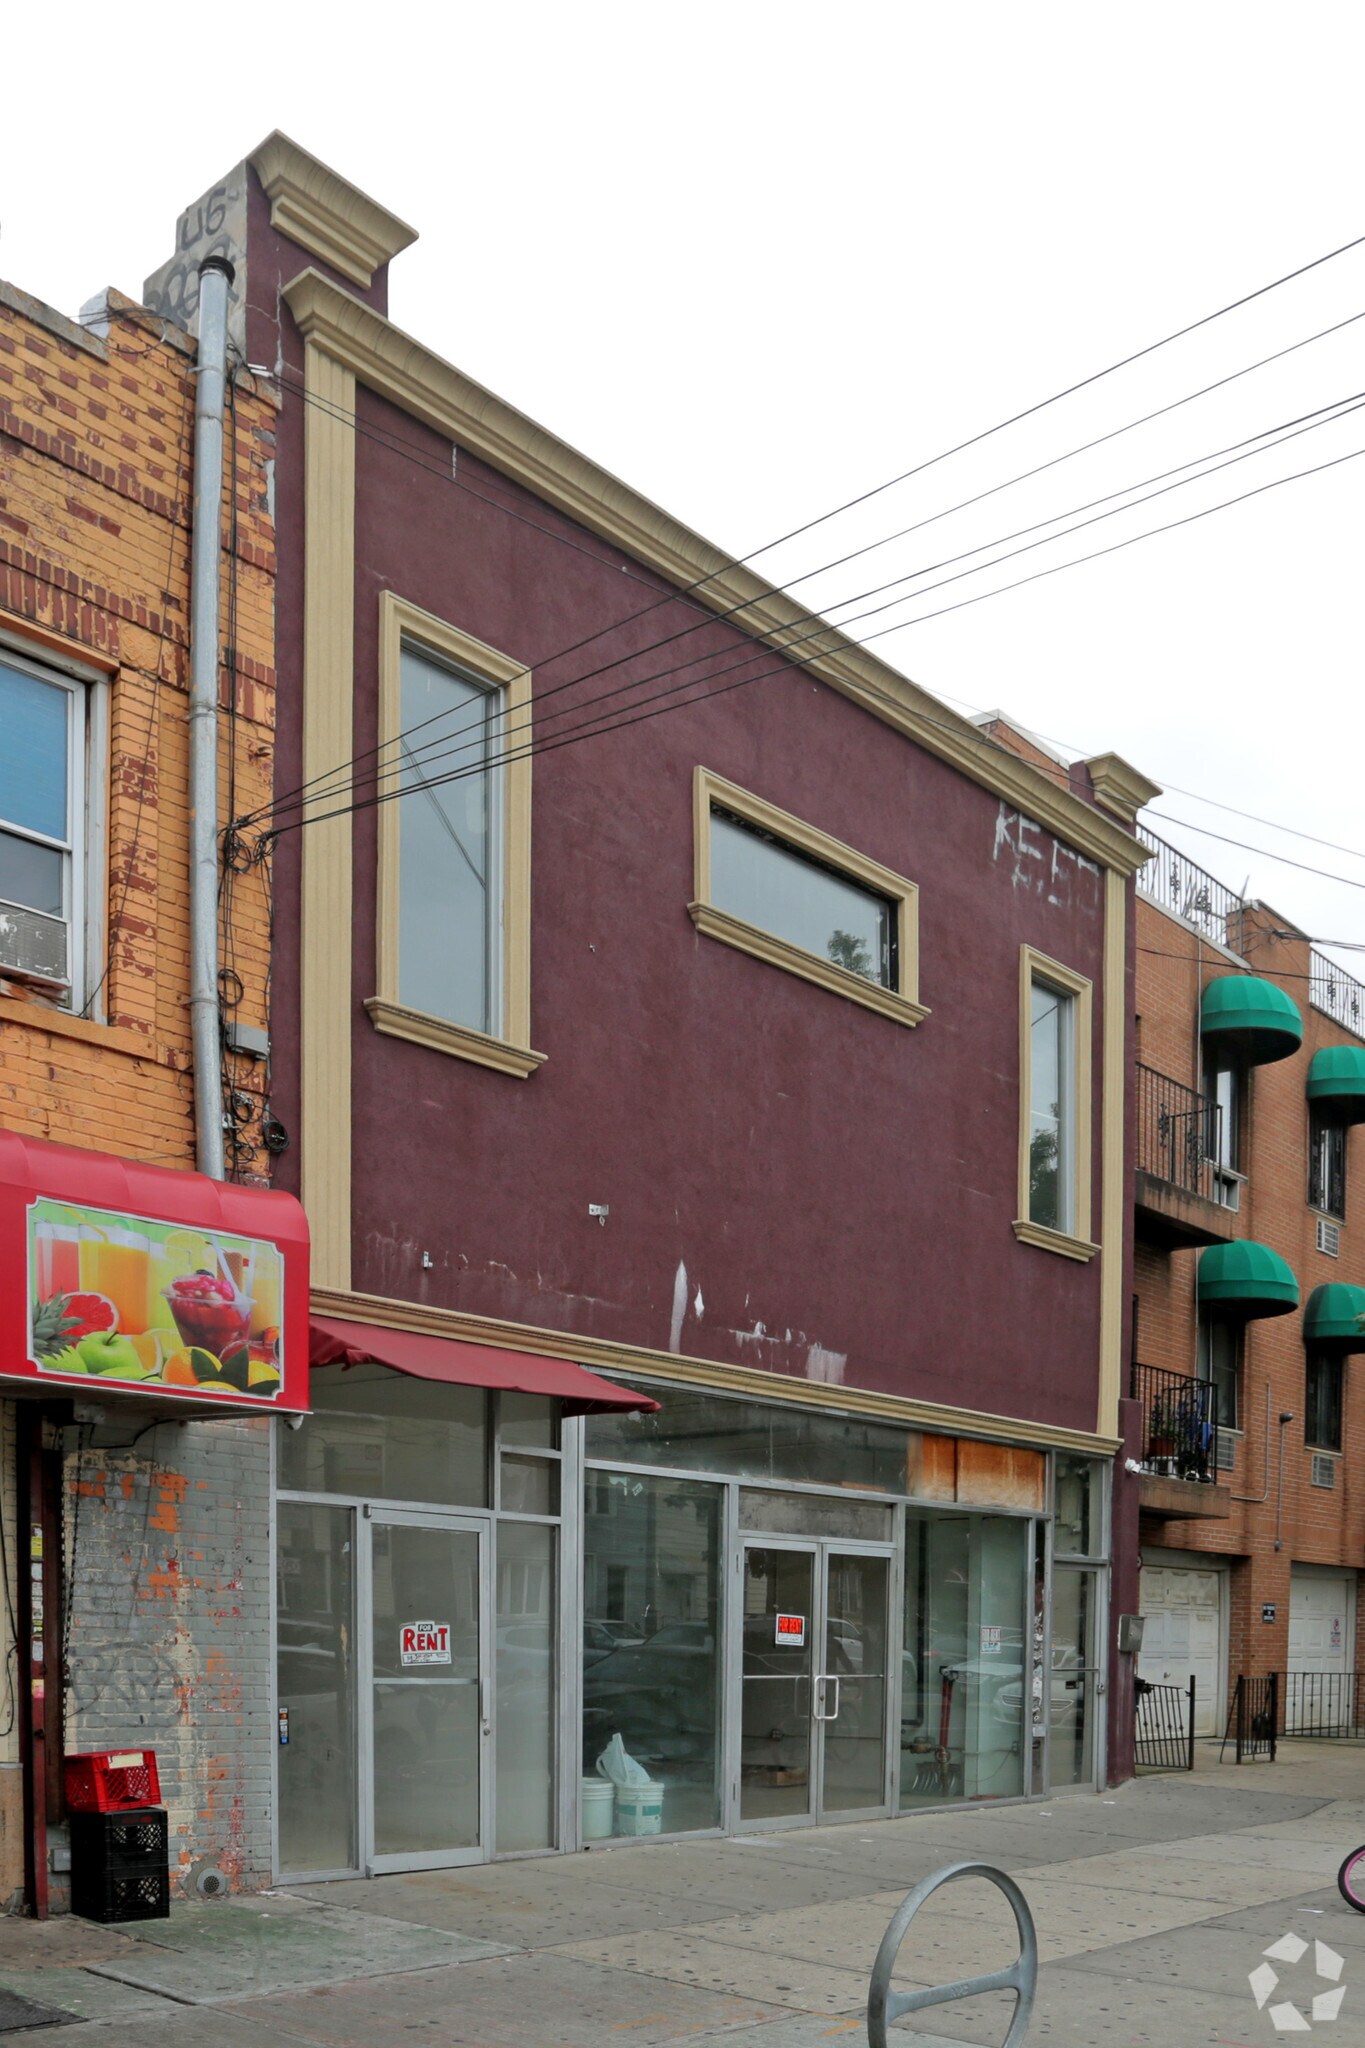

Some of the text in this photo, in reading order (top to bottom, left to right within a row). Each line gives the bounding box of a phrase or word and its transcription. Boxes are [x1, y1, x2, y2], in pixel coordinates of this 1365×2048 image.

[419, 1624, 432, 1632] FOR
[779, 1617, 802, 1635] FOR RENT
[403, 1627, 448, 1652] RENT
